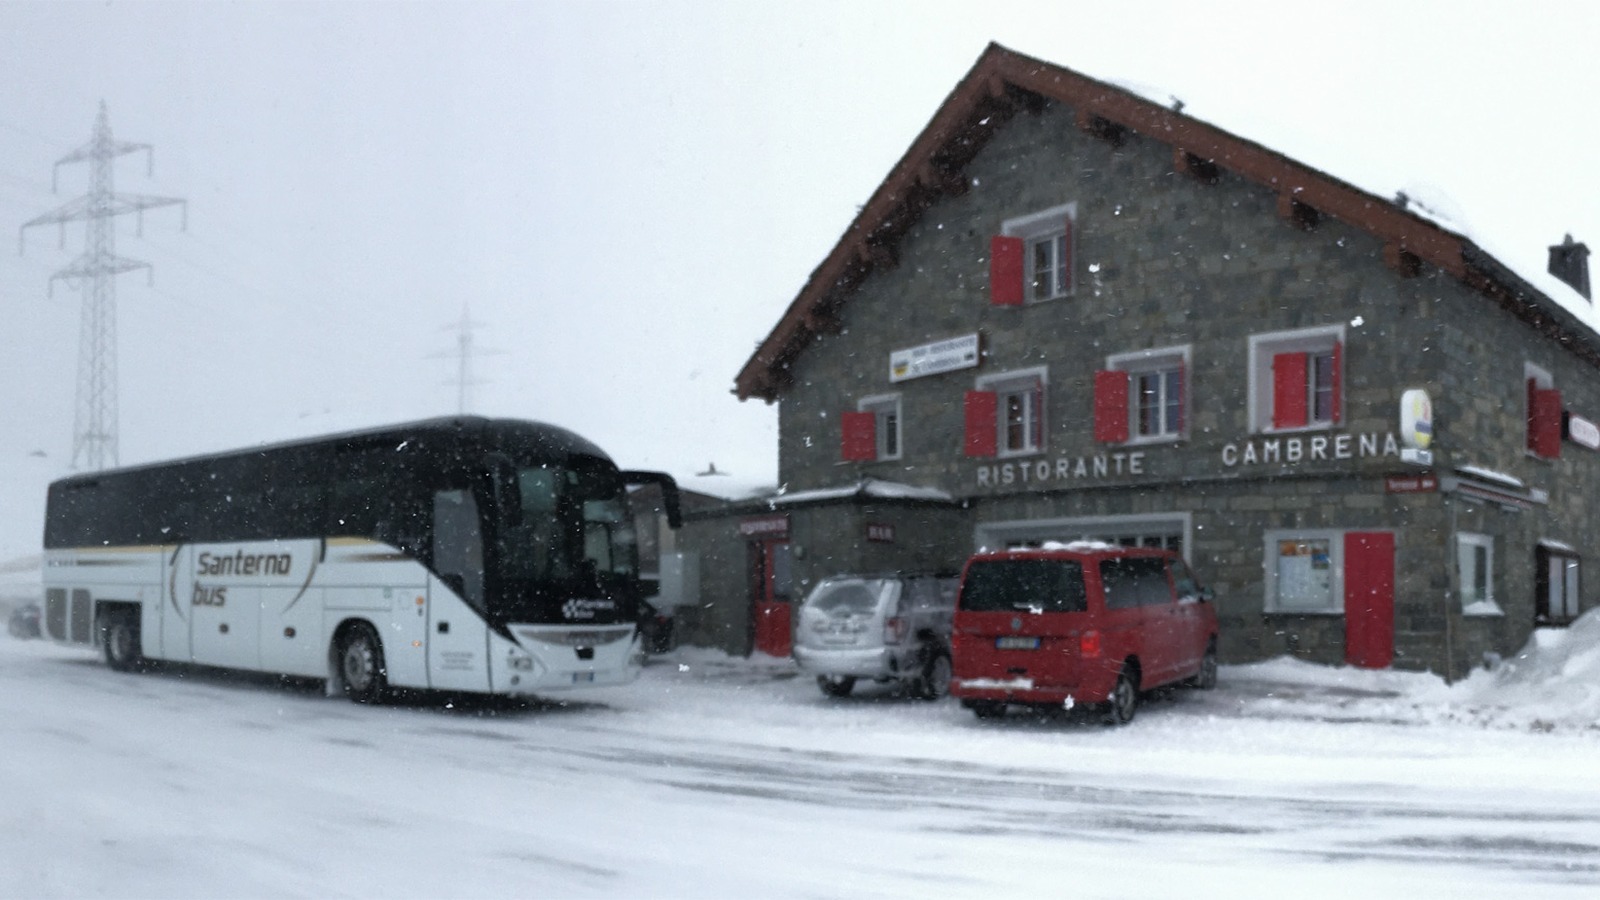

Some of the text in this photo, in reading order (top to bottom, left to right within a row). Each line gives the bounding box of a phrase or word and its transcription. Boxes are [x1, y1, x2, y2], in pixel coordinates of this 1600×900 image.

[977, 432, 1400, 487] RISTORANTE CAMBRENA
[197, 550, 292, 576] Santerno
[192, 581, 226, 607] bus
